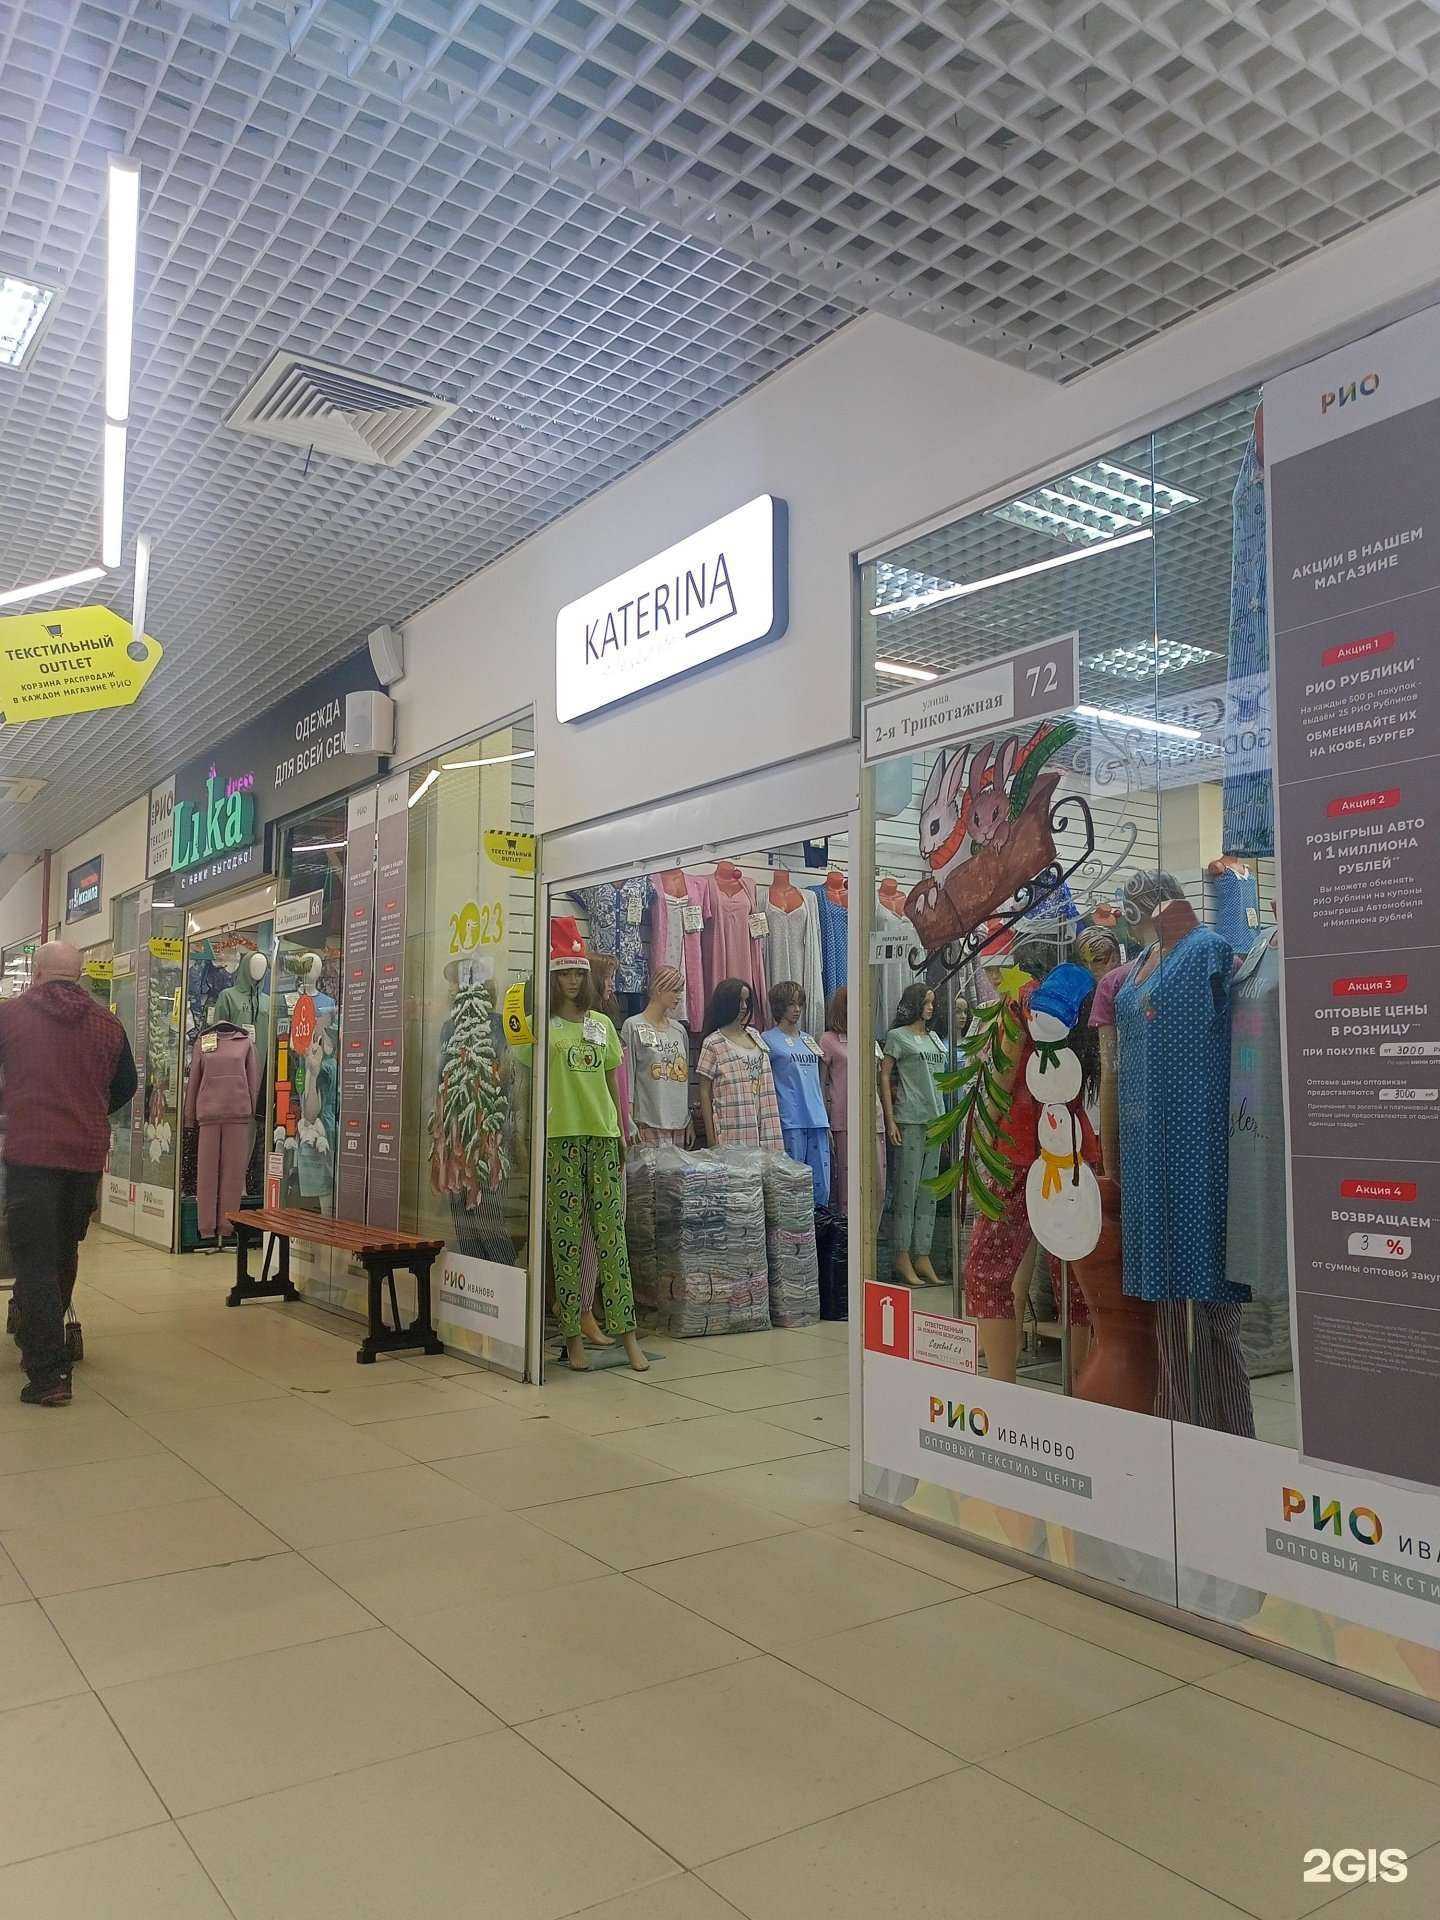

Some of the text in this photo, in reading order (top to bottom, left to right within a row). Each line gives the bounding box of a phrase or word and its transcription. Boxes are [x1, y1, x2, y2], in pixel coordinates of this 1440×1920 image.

[1321, 373, 1380, 415] РИО
[1292, 526, 1423, 581] АКЦИИ В НАШЕМ
[1314, 555, 1399, 590] МАГАЗИНЕ
[585, 552, 738, 665] KATERINA
[5, 634, 114, 661] ТЕКСТИЛЬНЫЙ
[1337, 640, 1379, 658] Акция 1
[40, 657, 93, 674] OUTLET
[21, 671, 116, 691] КОРЗИНА РАСПРОДАЖ
[1026, 662, 1058, 697] 72
[1305, 659, 1415, 696] РИО РУБЛИКИ
[22, 690, 61, 703] КАЖДОМ
[64, 684, 107, 696] МАГАЗИНЕ
[110, 679, 132, 690] РИО
[922, 695, 950, 712] улица
[1300, 705, 1311, 715] На
[1313, 697, 1347, 712] каждые
[1349, 692, 1366, 704] 500
[1302, 693, 1418, 726] выдаем 25 РИО Рубликов
[295, 698, 341, 741] ОДЕЖДА
[876, 693, 1003, 744] 2-я Трикотажная
[1306, 710, 1417, 742] ОБМЕНИВАЙТЕ ИХ
[1309, 727, 1415, 758] НА КОФЕ, БУРГЕР
[274, 762, 295, 789] ДЛЯ
[296, 738, 324, 775] ВСЕЙ
[1341, 795, 1385, 811] Акция 2
[1306, 818, 1425, 845] РОЗЫГРЫШ АВТО
[1313, 837, 1418, 861] И 1 МИЛЛИОНА
[1338, 856, 1392, 874] РУБЛЕЙ
[1313, 887, 1423, 906] РИО Рублики на купоны
[1334, 883, 1367, 892] можете
[311, 900, 320, 916] 66
[1313, 899, 1424, 919] розыгрыша Автомобиля
[1331, 916, 1377, 928] Миллиона
[1379, 912, 1413, 924] рублей
[1348, 980, 1392, 992] Акция 3
[1314, 1004, 1428, 1019] ОПТОВЫЕ ЦЕНЫ
[1331, 1023, 1411, 1036] В РОЗНИЦУ
[1302, 1048, 1323, 1057] ПРИ
[1326, 1047, 1376, 1056] ПОКУПКЕ
[1396, 1046, 1424, 1055] 3000
[1393, 1089, 1416, 1099] 3000
[1355, 1185, 1402, 1196] Акция 4
[1331, 1210, 1431, 1228] ВОЗВРАЩАЕМ
[1360, 1234, 1404, 1256] 3 %
[443, 1270, 466, 1290] РИО
[1325, 1261, 1360, 1273] суммы
[1362, 1266, 1408, 1278] оптовой
[965, 1359, 973, 1369] 01
[929, 1396, 1075, 1461] РИО ИВАНОВО
[924, 1435, 1086, 1491] ОПТОВЫЙ ТЕКСТИЛЬ ЦЕНТР
[1282, 1487, 1383, 1546] РИО
[1275, 1538, 1359, 1573] ОПТОВЫЙ
